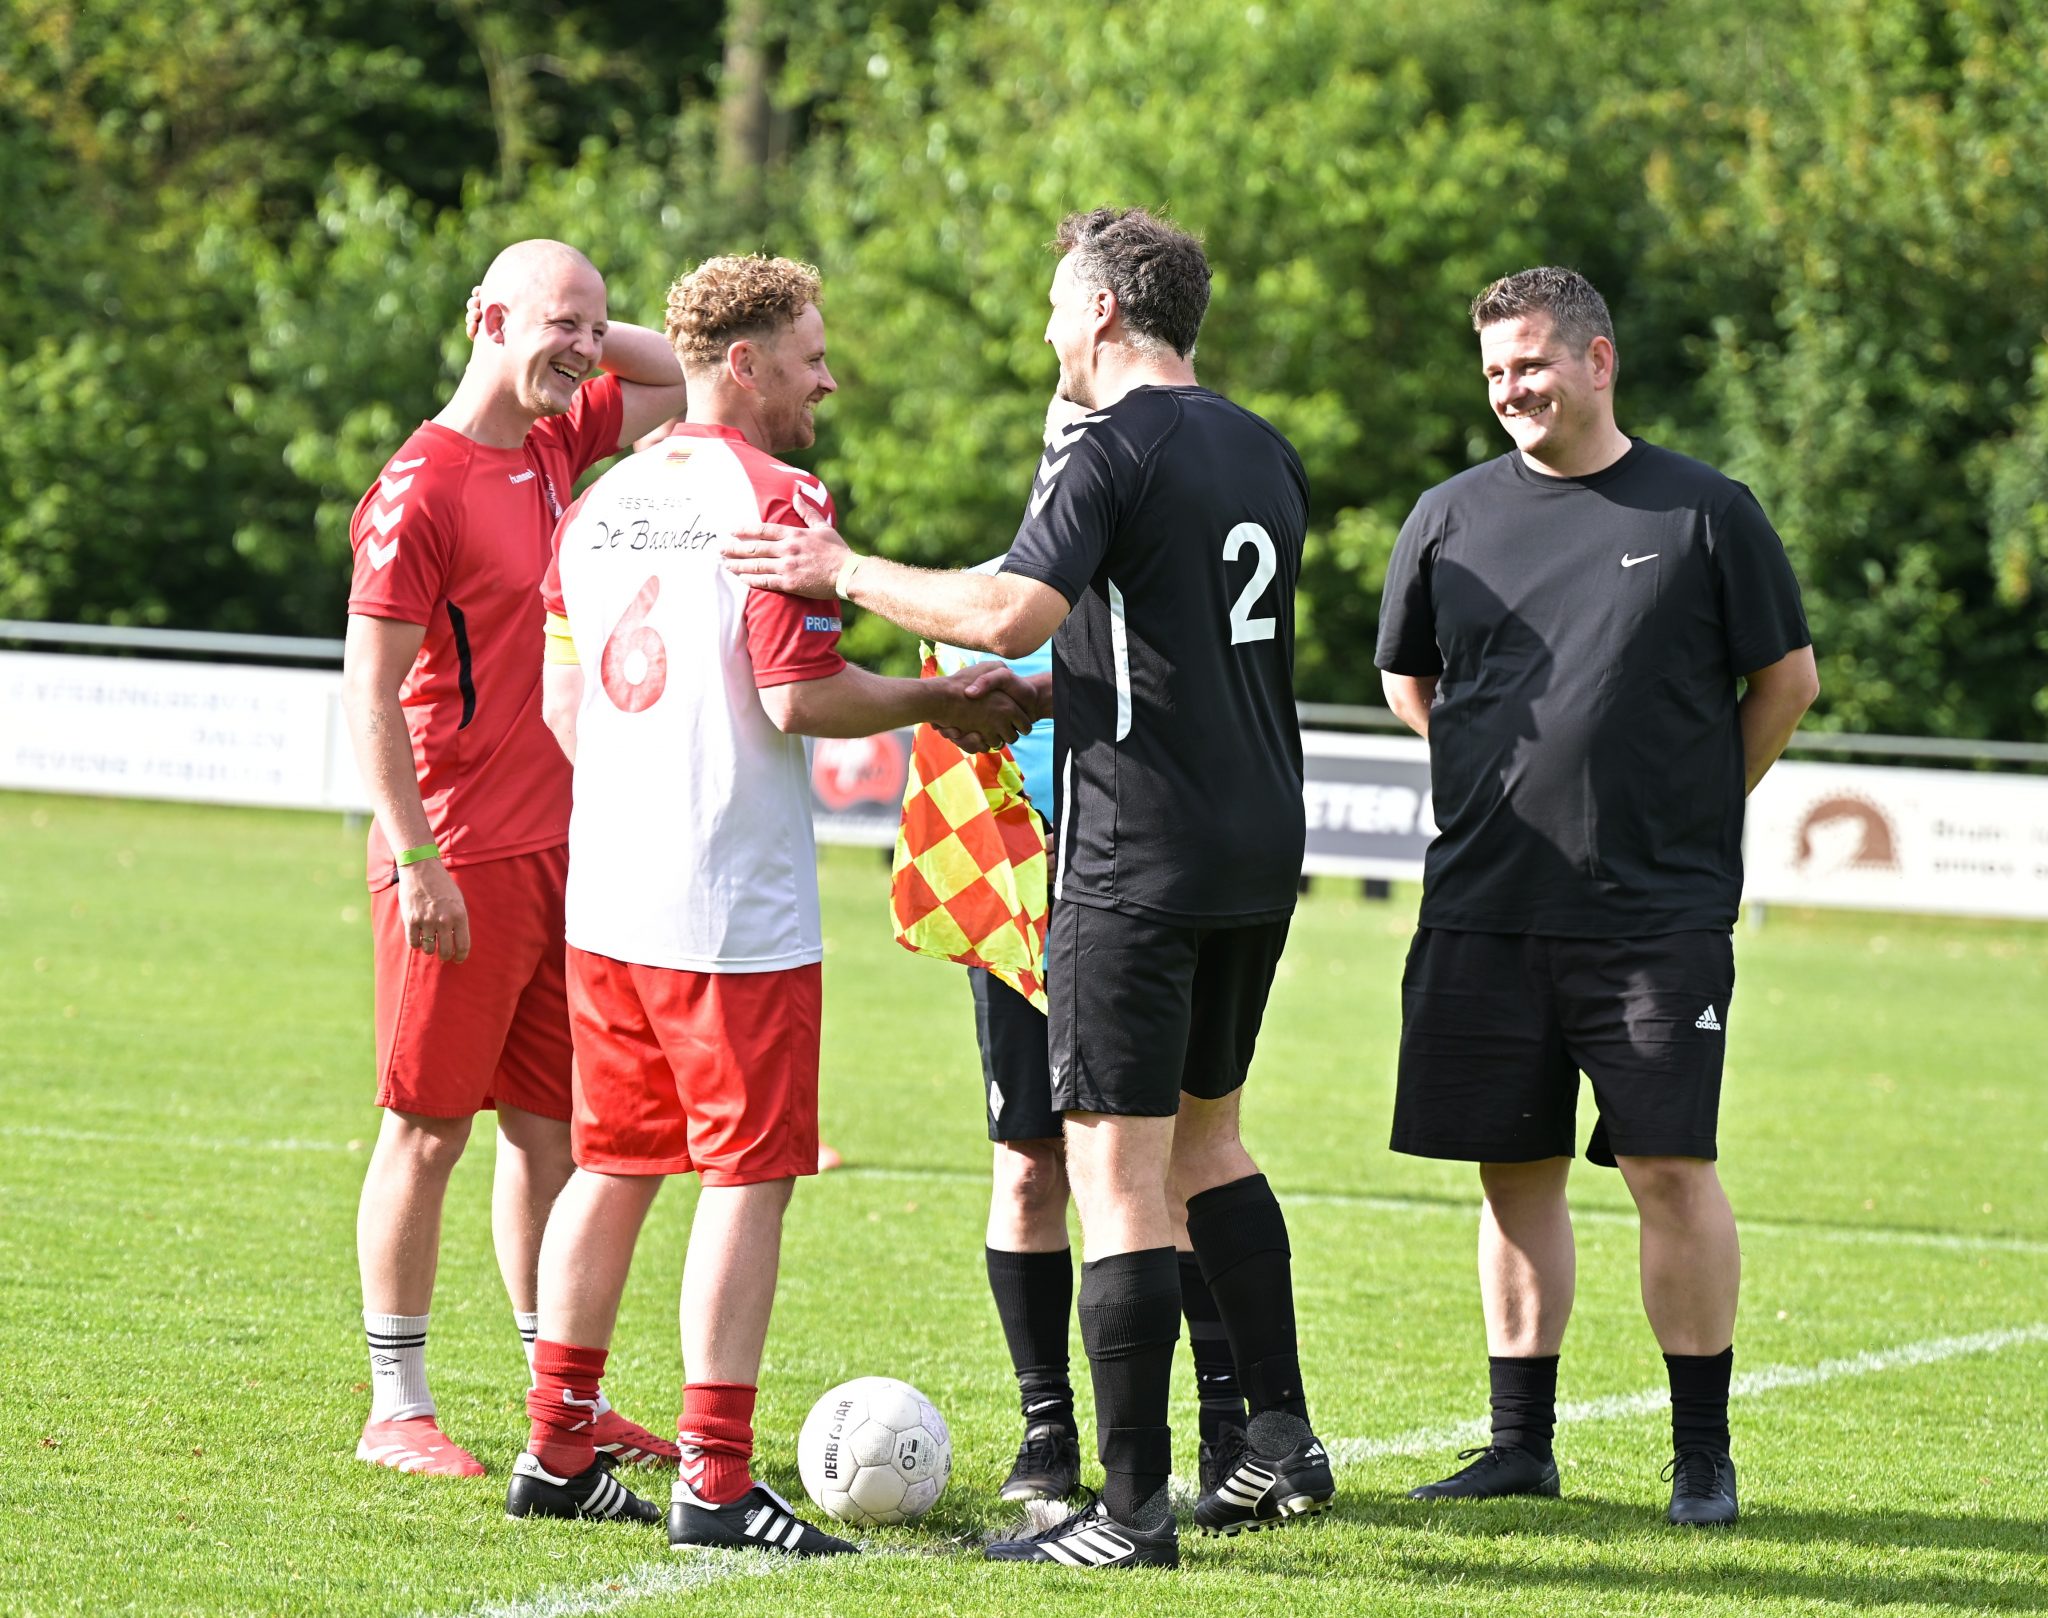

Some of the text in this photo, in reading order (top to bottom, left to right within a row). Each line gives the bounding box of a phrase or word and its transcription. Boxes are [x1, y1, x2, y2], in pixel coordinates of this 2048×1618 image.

[591, 521, 624, 549] De
[1222, 521, 1277, 646] 2
[600, 574, 668, 714] 6
[1694, 1020, 1722, 1031] adidas
